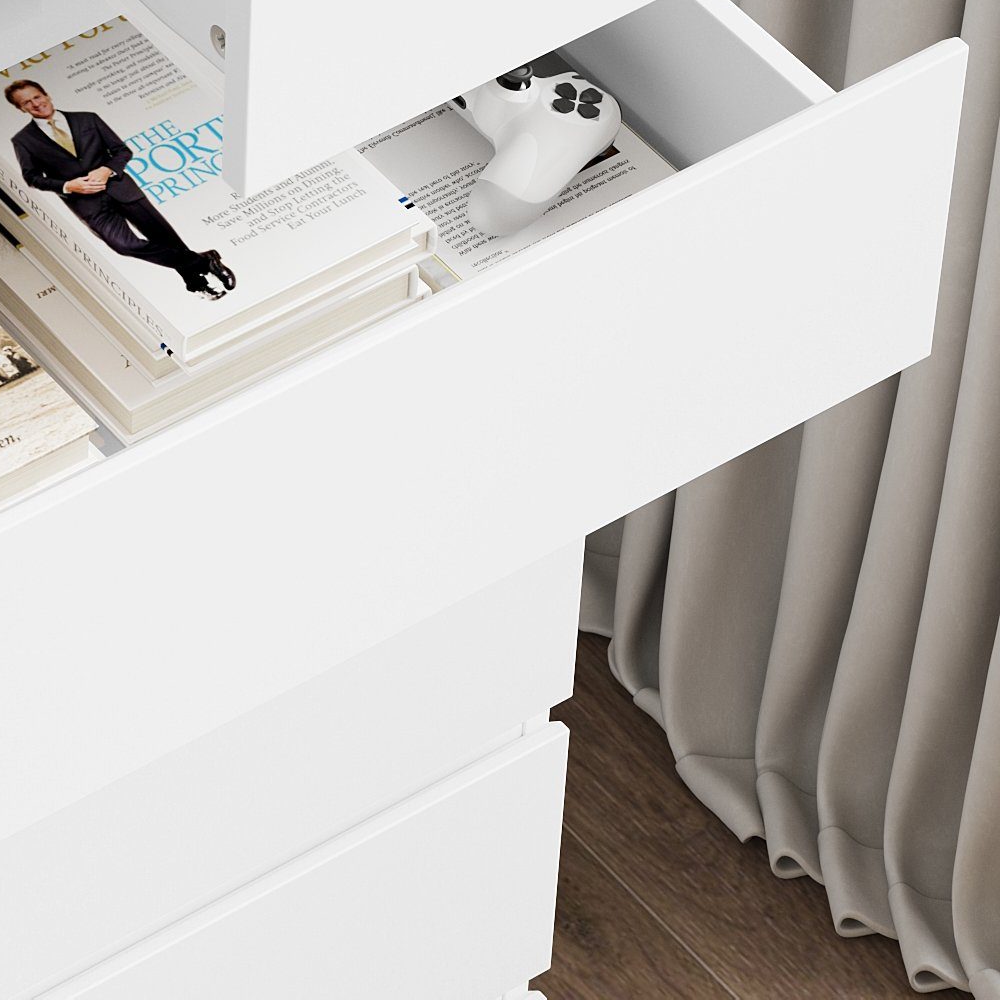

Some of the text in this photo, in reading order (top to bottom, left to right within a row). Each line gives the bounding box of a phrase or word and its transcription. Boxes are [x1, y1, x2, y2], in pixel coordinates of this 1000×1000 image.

[124, 119, 182, 152] THE
[125, 117, 224, 188] PORT
[201, 209, 229, 225] More
[228, 188, 274, 212] Students
[273, 177, 294, 191] and
[216, 214, 242, 229] Save
[241, 193, 286, 217] Millions
[287, 185, 303, 196] on
[229, 181, 358, 246] Food Service Contractors
[247, 173, 349, 227] and Stop Letting the
[286, 188, 366, 230] Eat Your Lunch
[8, 178, 67, 242] PORTER
[73, 242, 163, 346] PRINCIPLES
